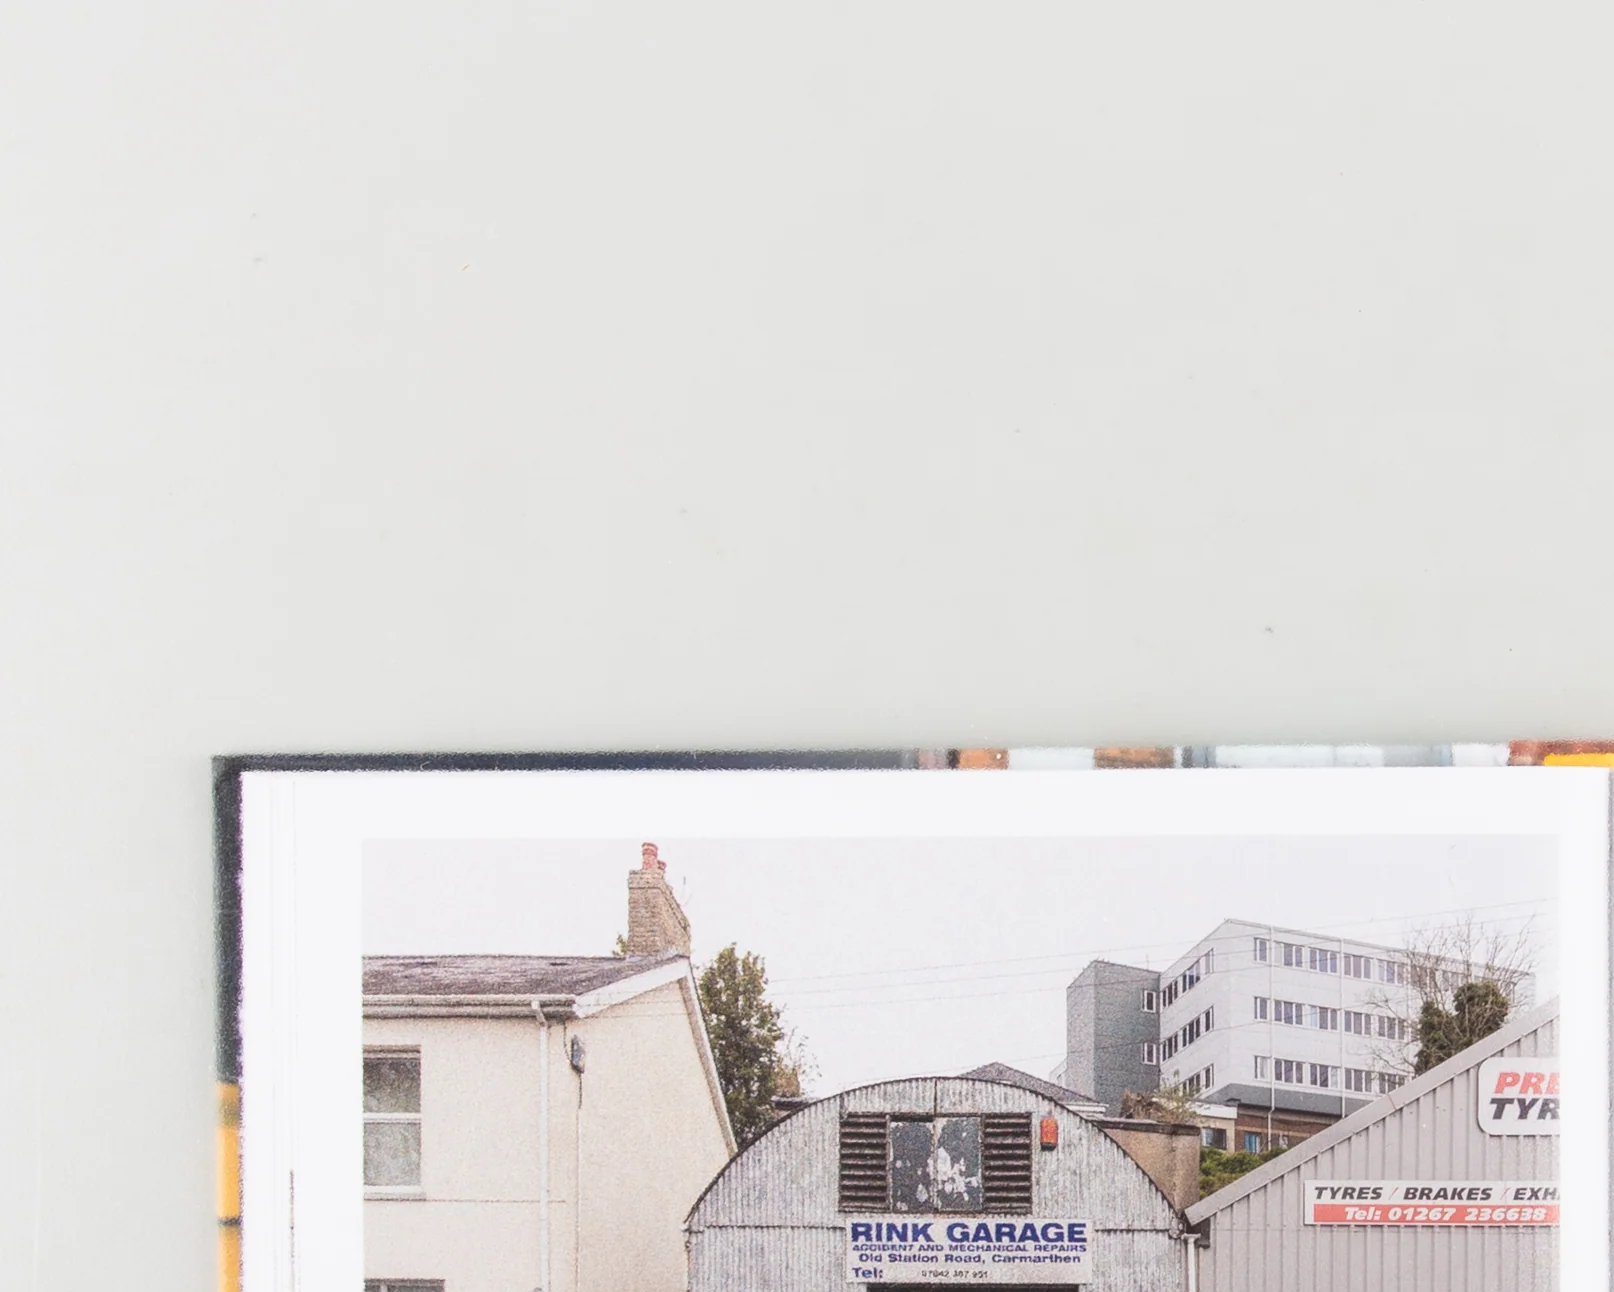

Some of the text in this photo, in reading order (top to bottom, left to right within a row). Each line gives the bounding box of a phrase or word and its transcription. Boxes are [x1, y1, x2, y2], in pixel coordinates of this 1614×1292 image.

[1489, 1098, 1560, 1121] TYR
[1314, 1186, 1383, 1200] TYRES
[1403, 1187, 1493, 1201] BRAKES
[1344, 1207, 1547, 1221] Tel: 01267 236638
[851, 1222, 1087, 1243] RINK GARAGE
[852, 1244, 1087, 1252] ACCIDENT AND MECHANICAL REPAIRS
[858, 1253, 1081, 1265] Old Station Road, Carmarthen
[852, 1267, 884, 1279] Tel:
